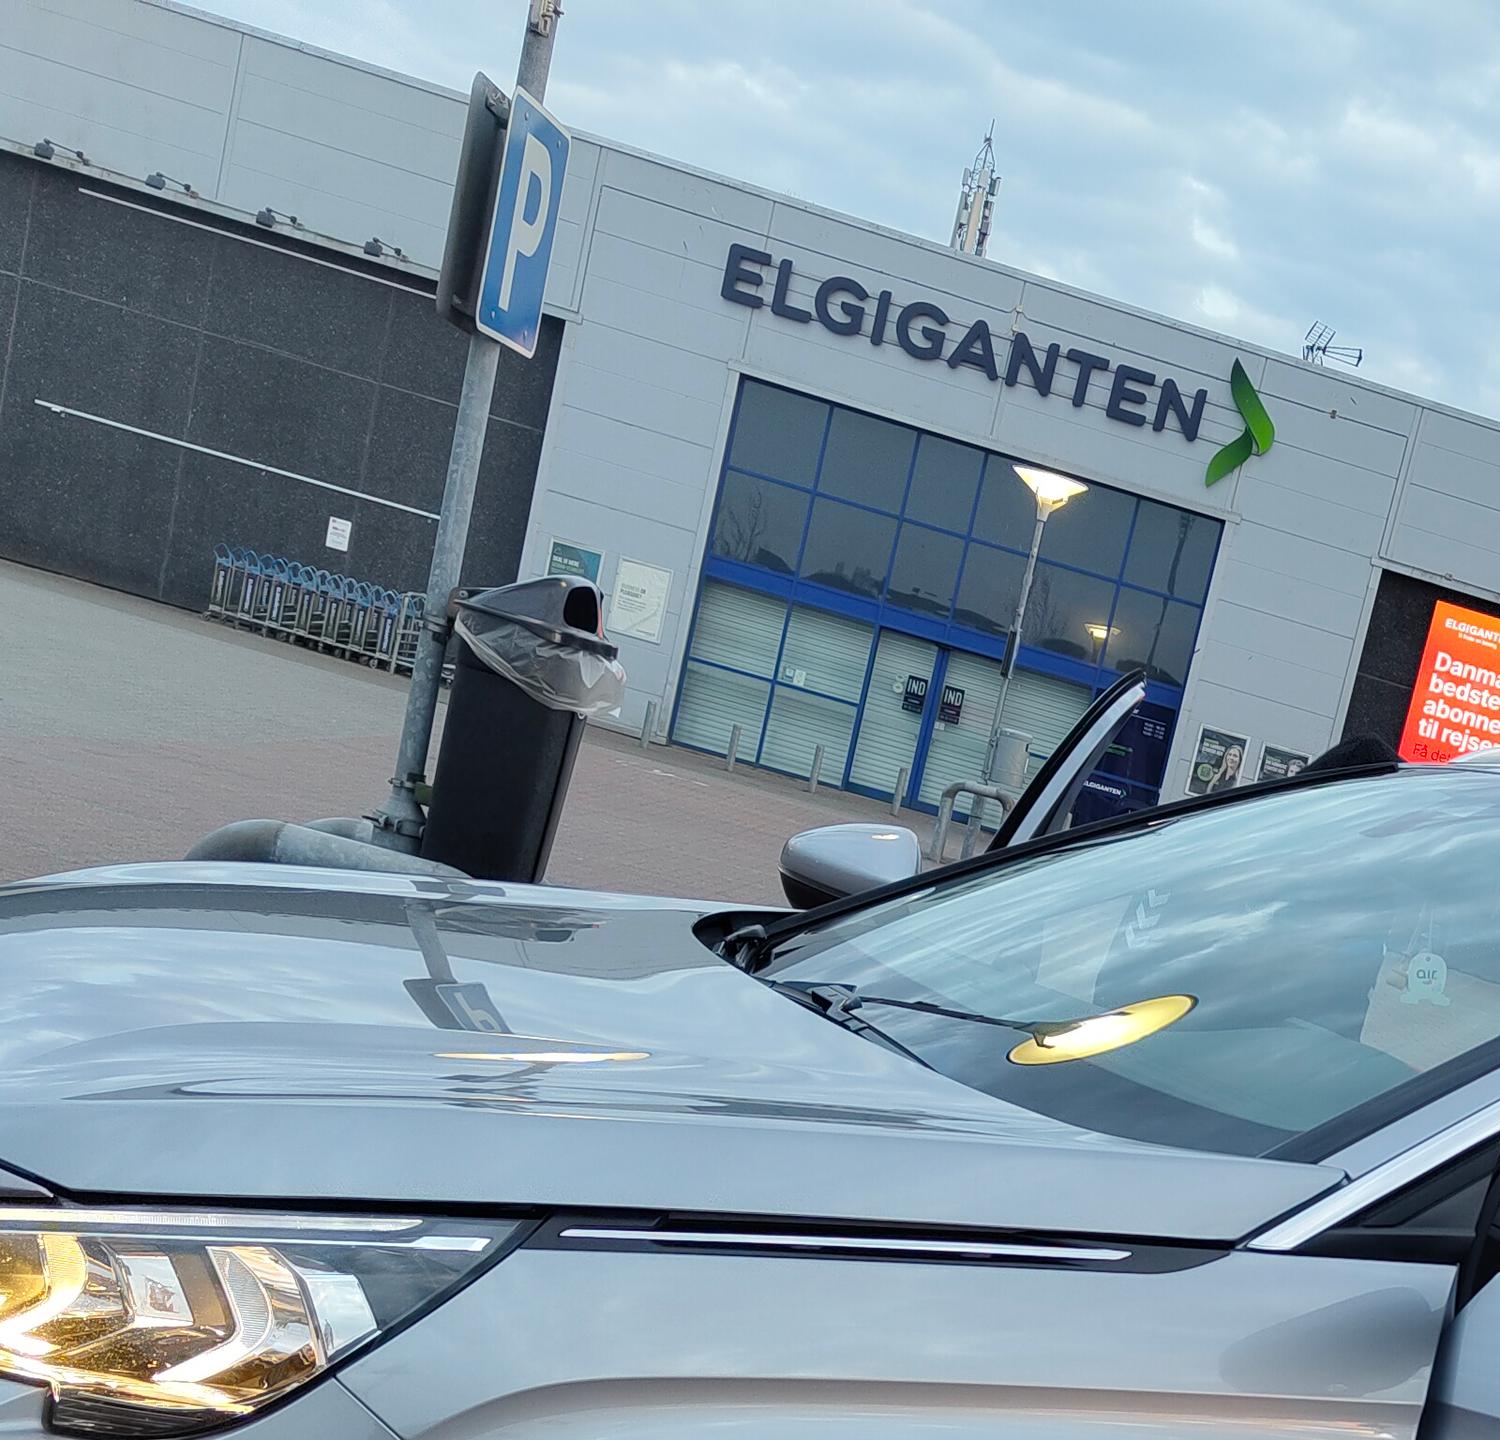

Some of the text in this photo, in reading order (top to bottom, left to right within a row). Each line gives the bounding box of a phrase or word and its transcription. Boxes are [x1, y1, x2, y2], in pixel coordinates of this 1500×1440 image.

[498, 131, 552, 313] P
[720, 243, 1208, 442] ELGIGANTEN
[907, 678, 926, 696] IND
[944, 688, 963, 707] IND
[1418, 718, 1440, 740] til
[1413, 743, 1428, 759] Få
